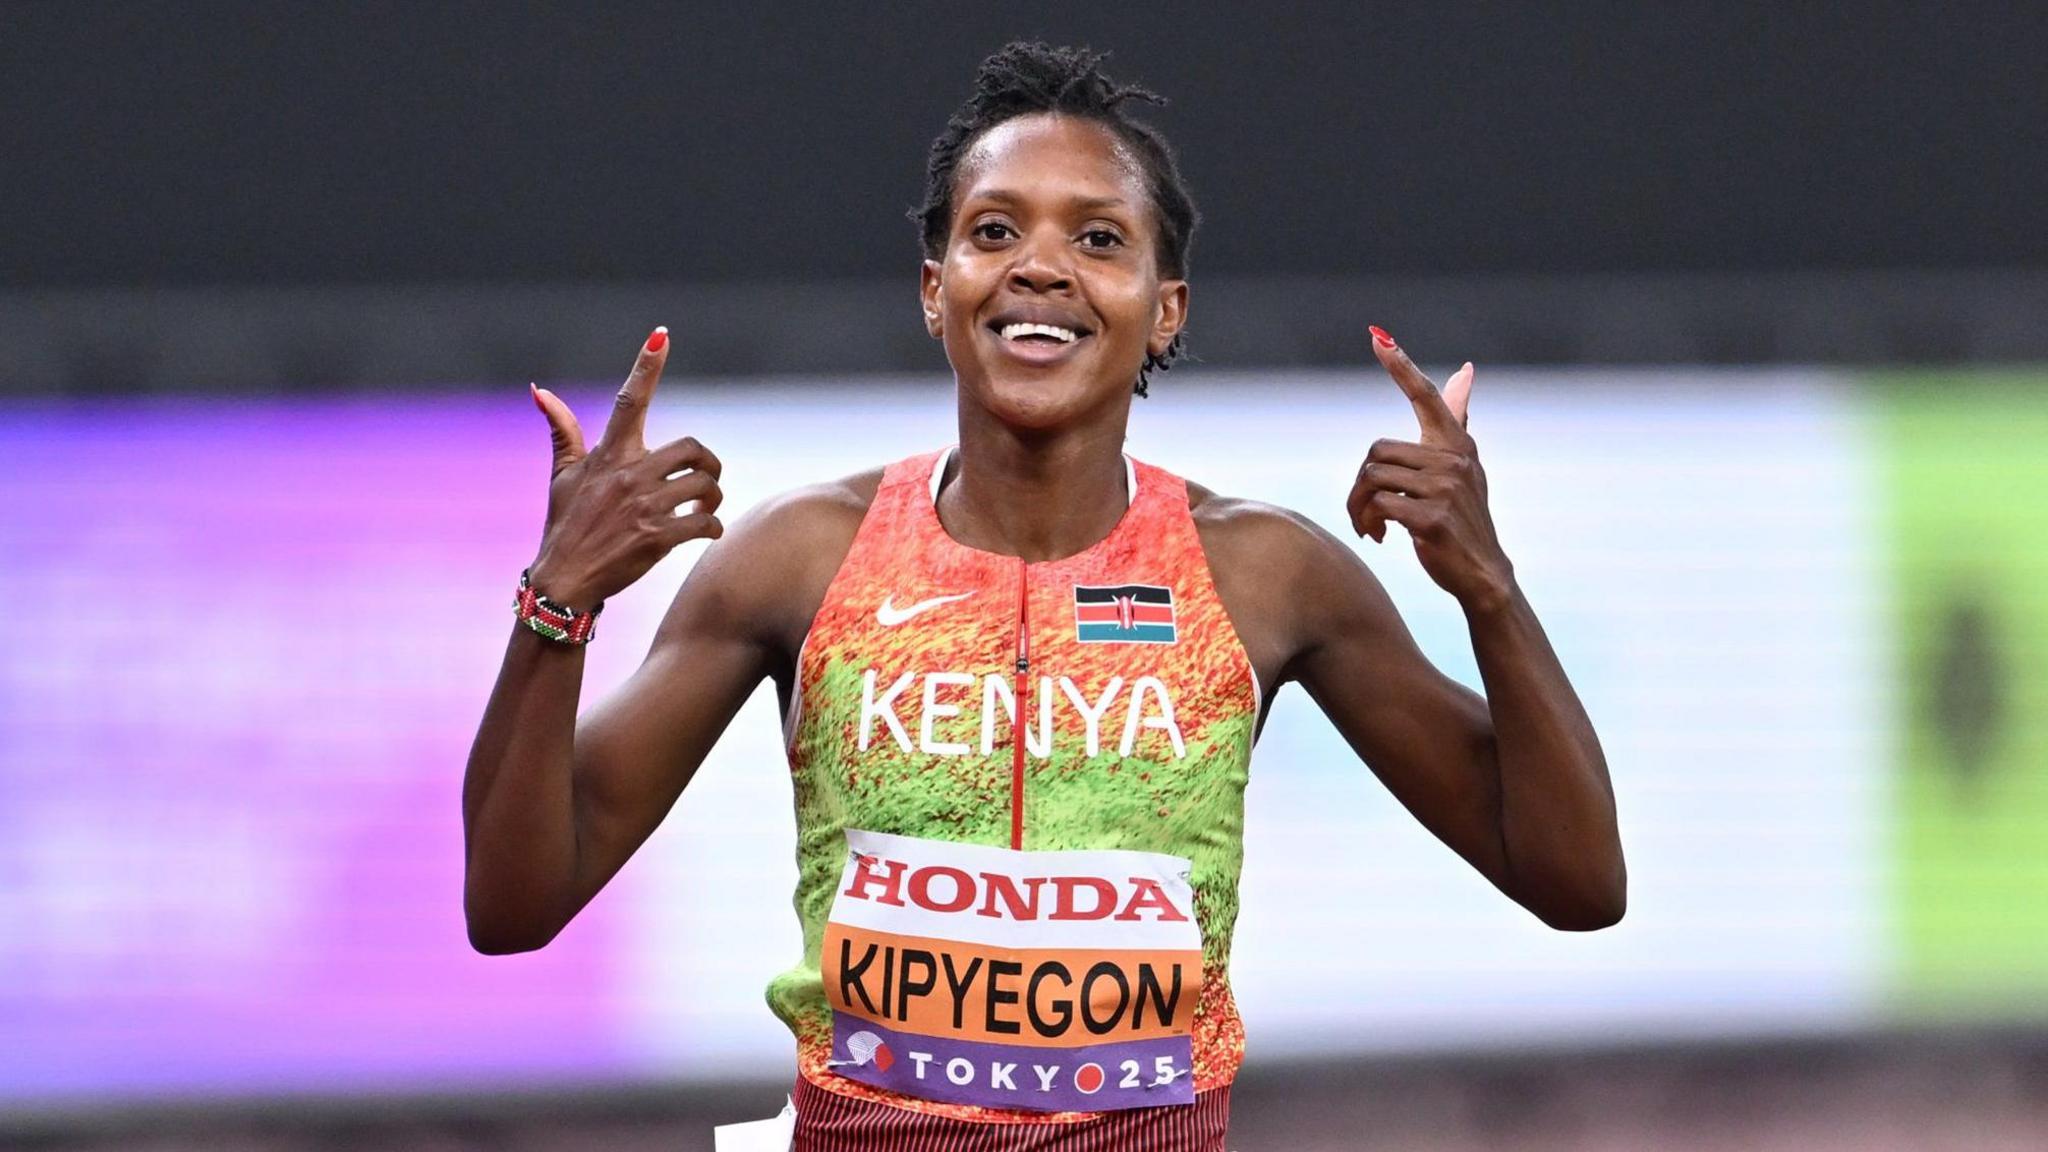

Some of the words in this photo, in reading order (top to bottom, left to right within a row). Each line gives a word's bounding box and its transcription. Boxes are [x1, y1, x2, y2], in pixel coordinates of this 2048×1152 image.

[858, 669, 1187, 759] KENYA
[843, 856, 1189, 922] HONDA
[838, 938, 1182, 1039] KIPYEGON
[1119, 1055, 1176, 1089] 25
